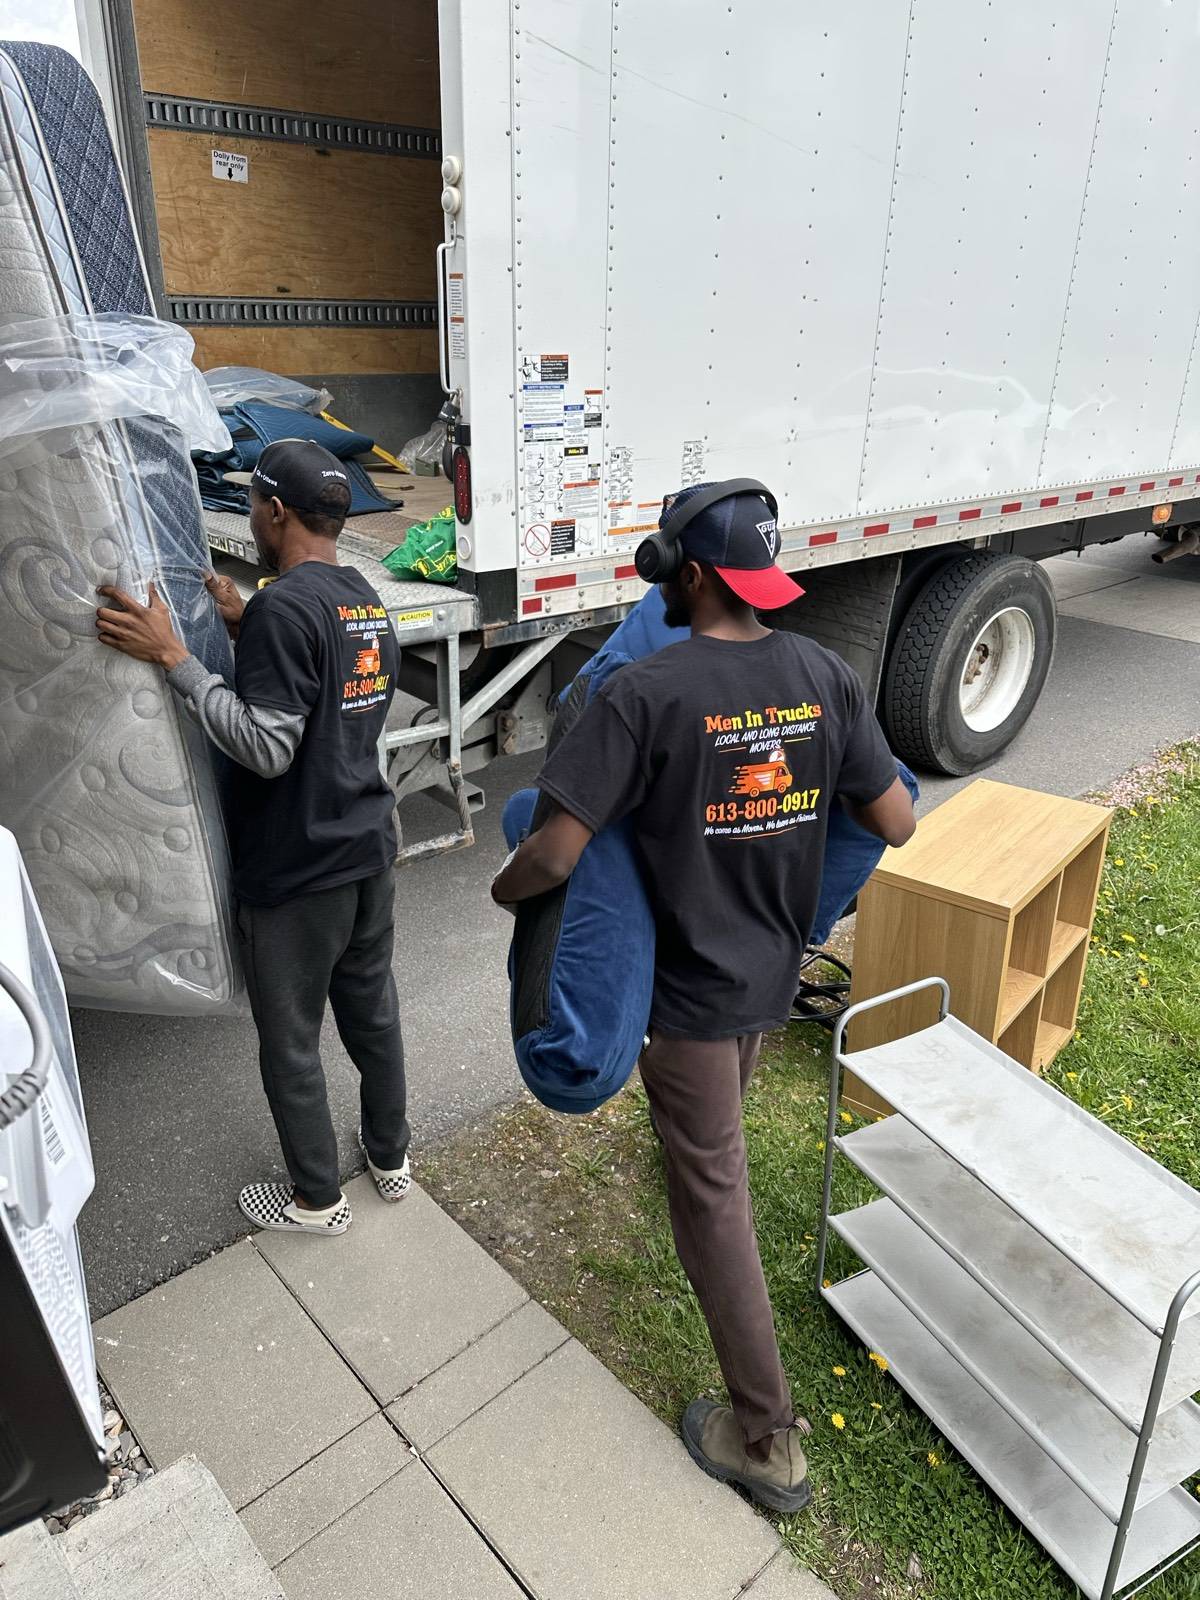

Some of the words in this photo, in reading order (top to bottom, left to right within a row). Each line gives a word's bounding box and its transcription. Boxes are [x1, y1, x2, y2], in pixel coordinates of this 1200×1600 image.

[213, 151, 230, 161] Dolly
[231, 154, 246, 163] from
[230, 162, 244, 171] only
[337, 606, 358, 621] Men
[357, 605, 367, 620] In
[406, 612, 431, 620] CAUTION
[704, 715, 742, 733] Men
[745, 710, 763, 728] In
[765, 702, 822, 724] Trucks
[714, 735, 740, 747] LOCAL
[741, 731, 758, 743] AND
[759, 727, 780, 740] LONG
[781, 721, 818, 736] DISTANCE
[749, 739, 781, 754] MOVERS
[705, 788, 820, 823] 613-800-0917
[704, 826, 714, 836] We
[732, 826, 741, 834] as
[765, 821, 776, 830] We
